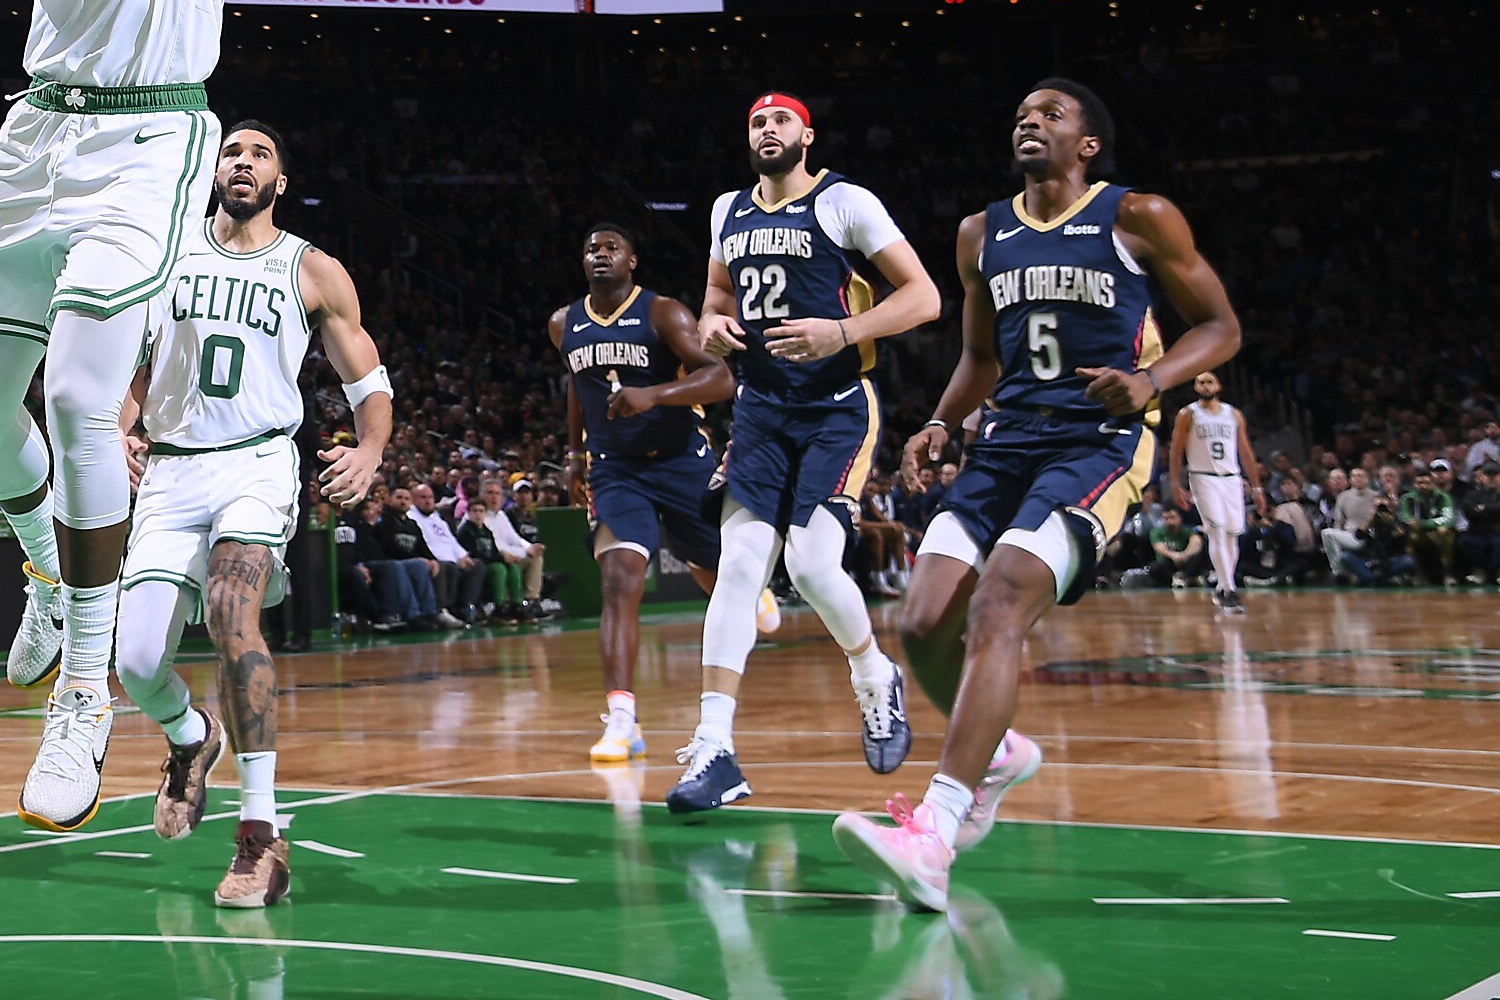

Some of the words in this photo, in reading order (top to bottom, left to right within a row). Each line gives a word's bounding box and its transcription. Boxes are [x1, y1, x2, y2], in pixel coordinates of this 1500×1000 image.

[750, 228, 812, 258] ORLEANS
[1063, 225, 1100, 235] ibotta
[263, 267, 287, 275] PRINT
[265, 258, 287, 269] VISTA
[739, 263, 790, 321] 22
[1024, 265, 1117, 309] ORLEANS
[172, 274, 286, 337] CELTICS
[596, 343, 649, 368] ORLEANS
[1028, 312, 1062, 381] 5
[198, 333, 245, 399] 0
[1211, 441, 1225, 461] 9
